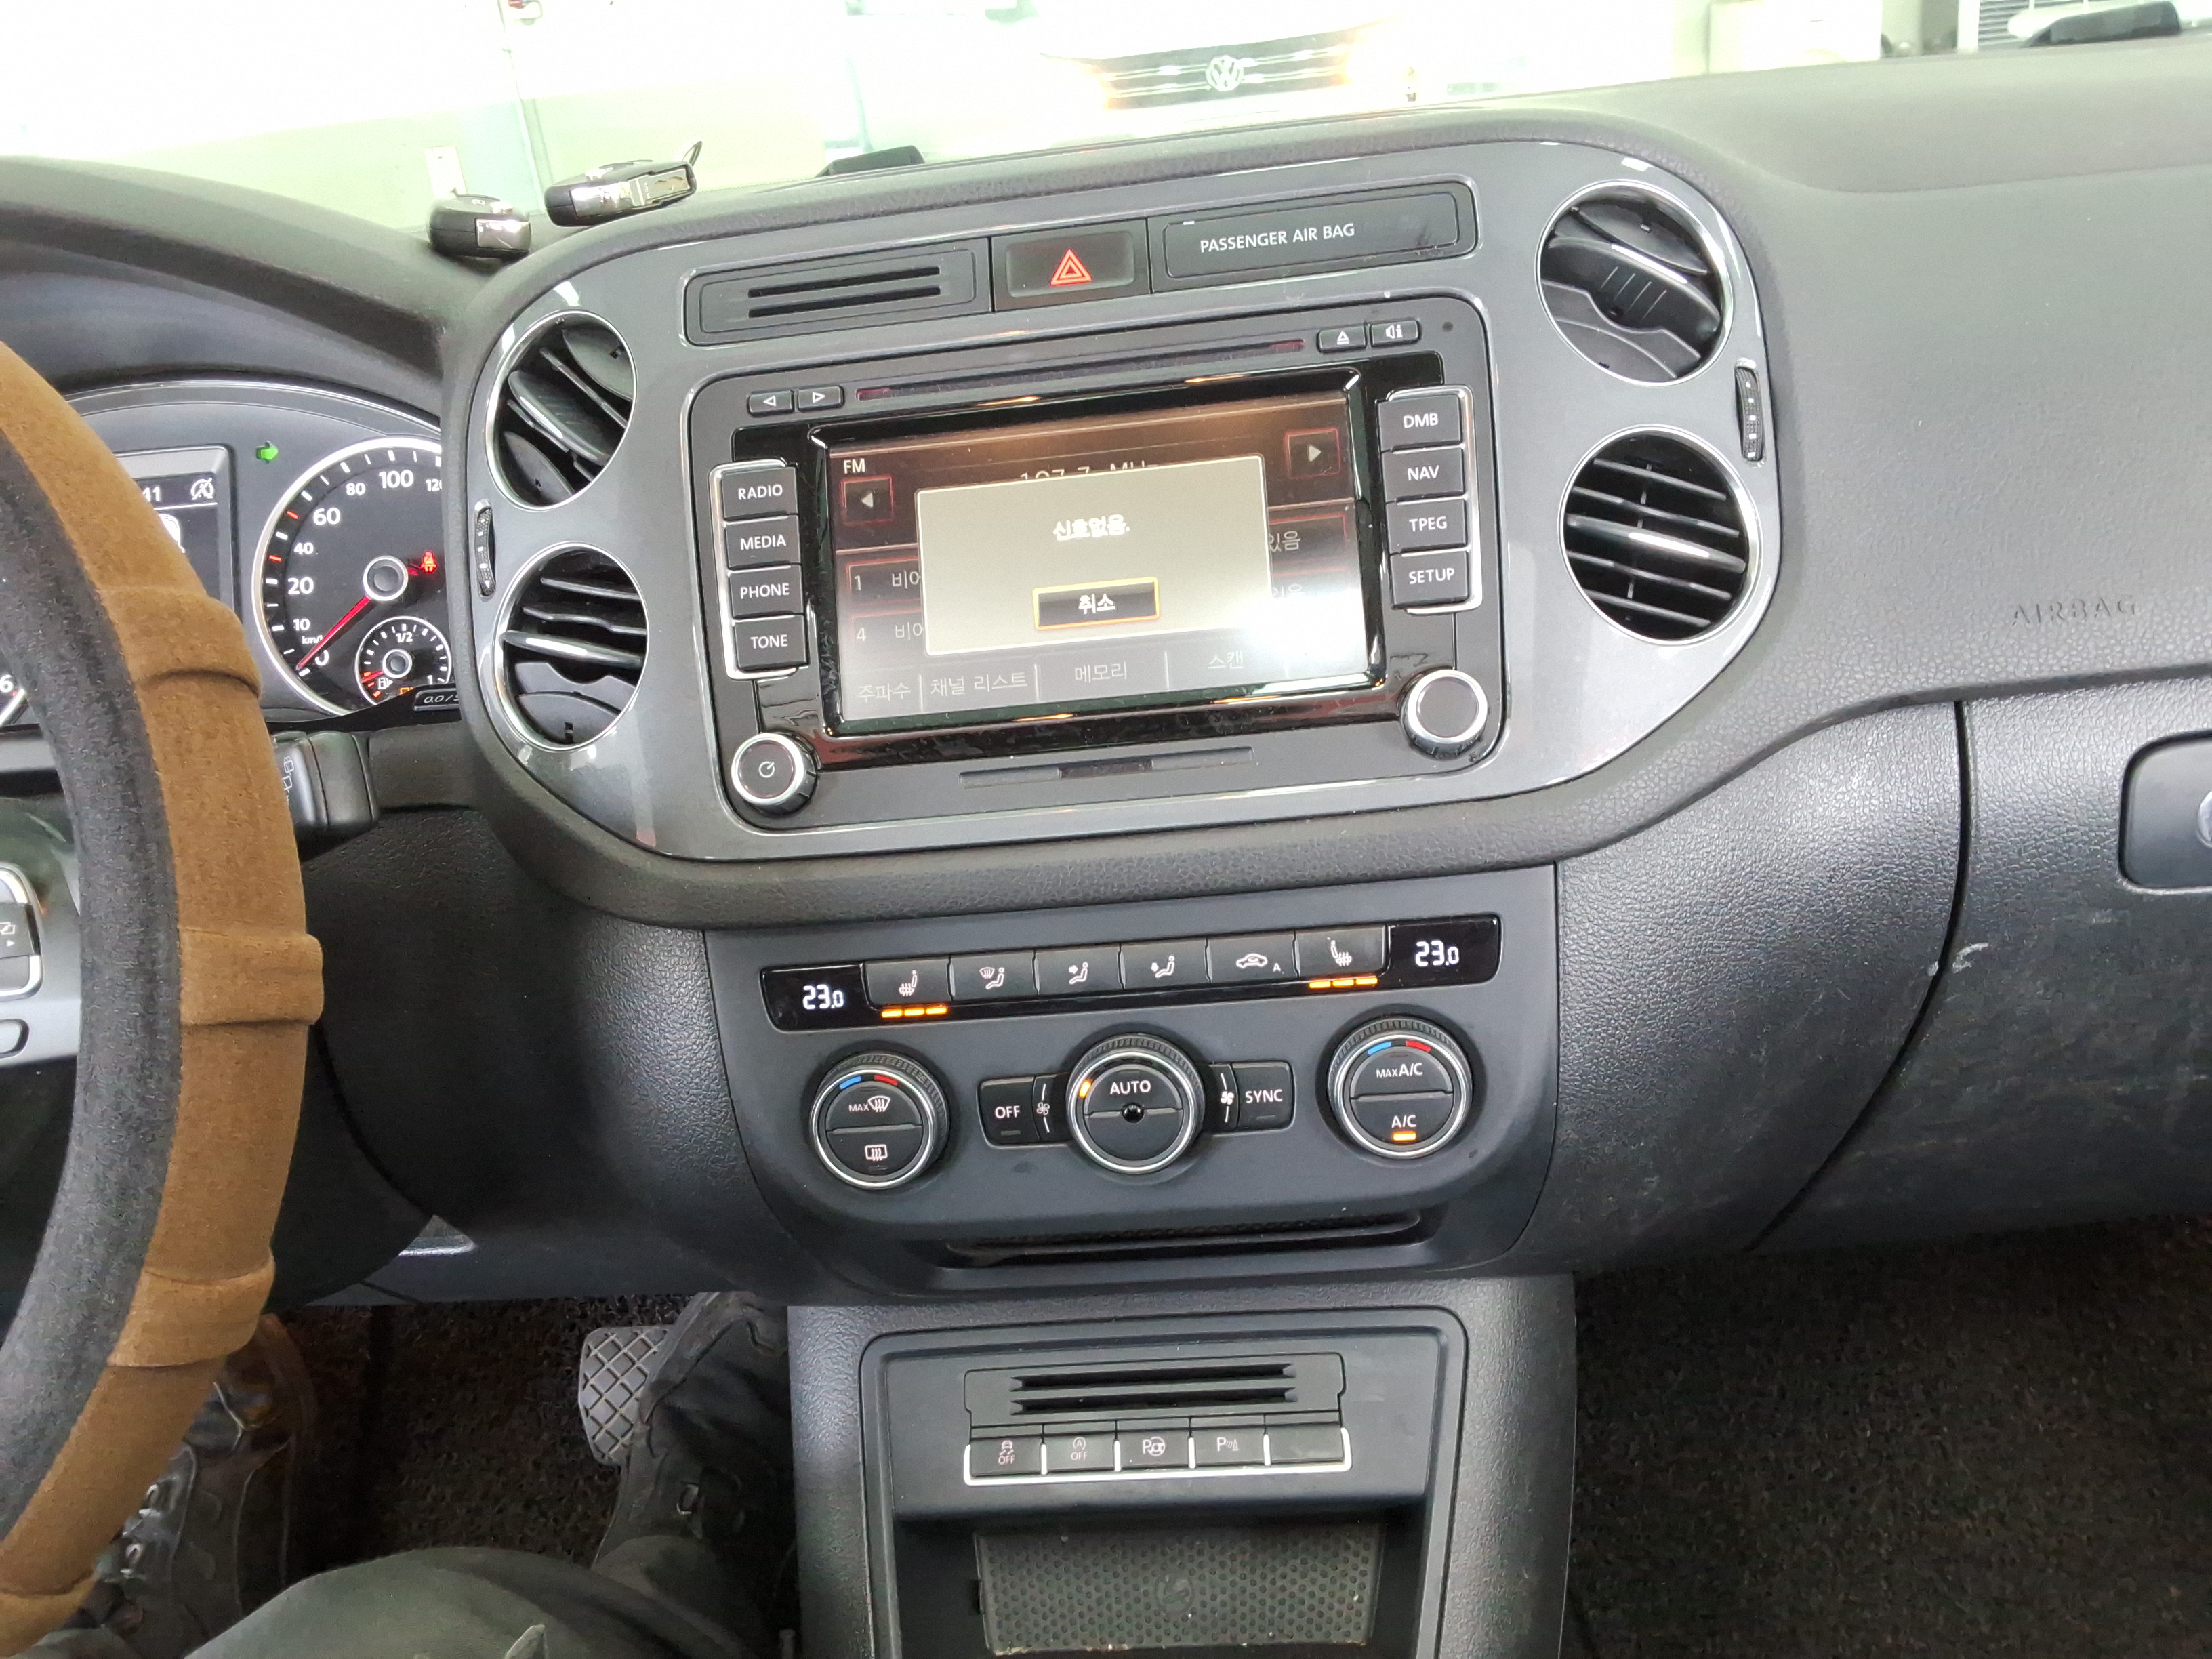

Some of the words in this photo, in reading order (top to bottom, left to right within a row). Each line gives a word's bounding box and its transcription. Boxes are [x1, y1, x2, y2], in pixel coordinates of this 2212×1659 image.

[1200, 230, 1287, 253] PASSENGER
[1292, 228, 1318, 243] AIR
[1323, 222, 1355, 239] BAG
[1403, 413, 1438, 430] DMB
[843, 458, 866, 474] FM
[1407, 466, 1440, 481] NAV
[379, 470, 413, 489] 100
[425, 478, 443, 491] 12
[346, 483, 366, 495] 80
[737, 484, 783, 500] RADIO
[312, 507, 341, 526] 60
[1408, 516, 1448, 531] TPEG
[293, 542, 314, 555] 40
[739, 534, 787, 550] MEDIA
[854, 575, 862, 591] 1
[1408, 567, 1455, 585] SETUP
[287, 577, 314, 595] 20
[739, 582, 790, 599] PHONE
[1078, 593, 1116, 615] 취소
[2011, 596, 2137, 626] AIRBAG
[293, 618, 310, 632] 10
[396, 632, 413, 644] 1/2
[750, 634, 788, 649] TONE
[856, 626, 867, 642] 4
[314, 649, 330, 666] 0
[1208, 650, 1244, 670] 스캔
[427, 674, 434, 684] 1
[1074, 659, 1128, 684] 메모리
[0, 674, 12, 693] 6
[930, 675, 965, 696] 채널
[974, 671, 1028, 693] 리스트
[858, 682, 912, 702] 주파수
[1414, 940, 1460, 967] 23.0
[802, 983, 845, 1010] 23.0
[1375, 1068, 1398, 1079] MAX
[1398, 1062, 1423, 1078] A/C
[1109, 1080, 1152, 1096] AUTO
[1244, 1089, 1284, 1103] SYNC
[848, 1103, 869, 1113] MAX
[995, 1105, 1021, 1119] OFF
[1391, 1113, 1417, 1128] A/C
[998, 1455, 1015, 1466] OFF
[1071, 1451, 1088, 1461] OFF
